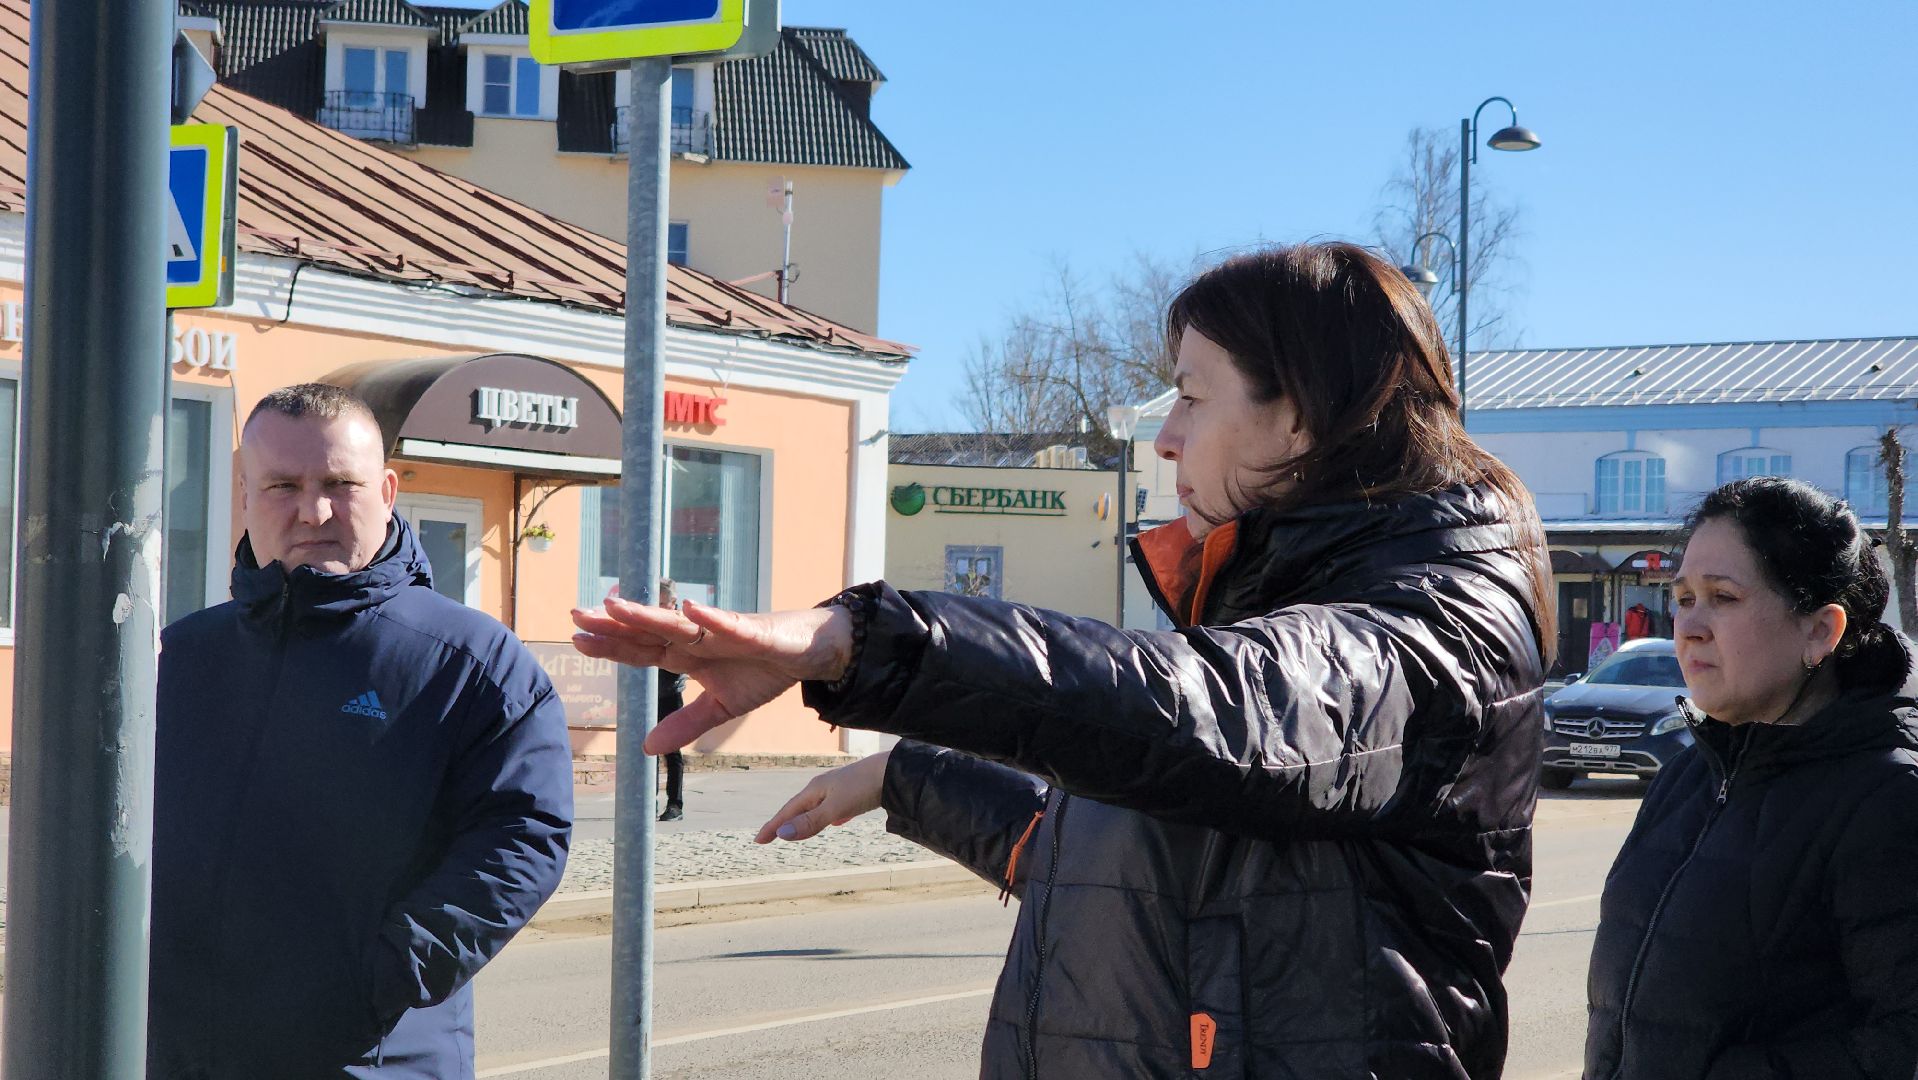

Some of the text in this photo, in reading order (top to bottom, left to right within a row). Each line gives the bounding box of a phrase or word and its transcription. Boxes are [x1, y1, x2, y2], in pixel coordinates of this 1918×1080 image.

[477, 386, 579, 428] ЦВЕТЫ
[665, 390, 728, 426] МТС
[932, 486, 1067, 510] СБЕРБАНК
[341, 704, 387, 719] adidas
